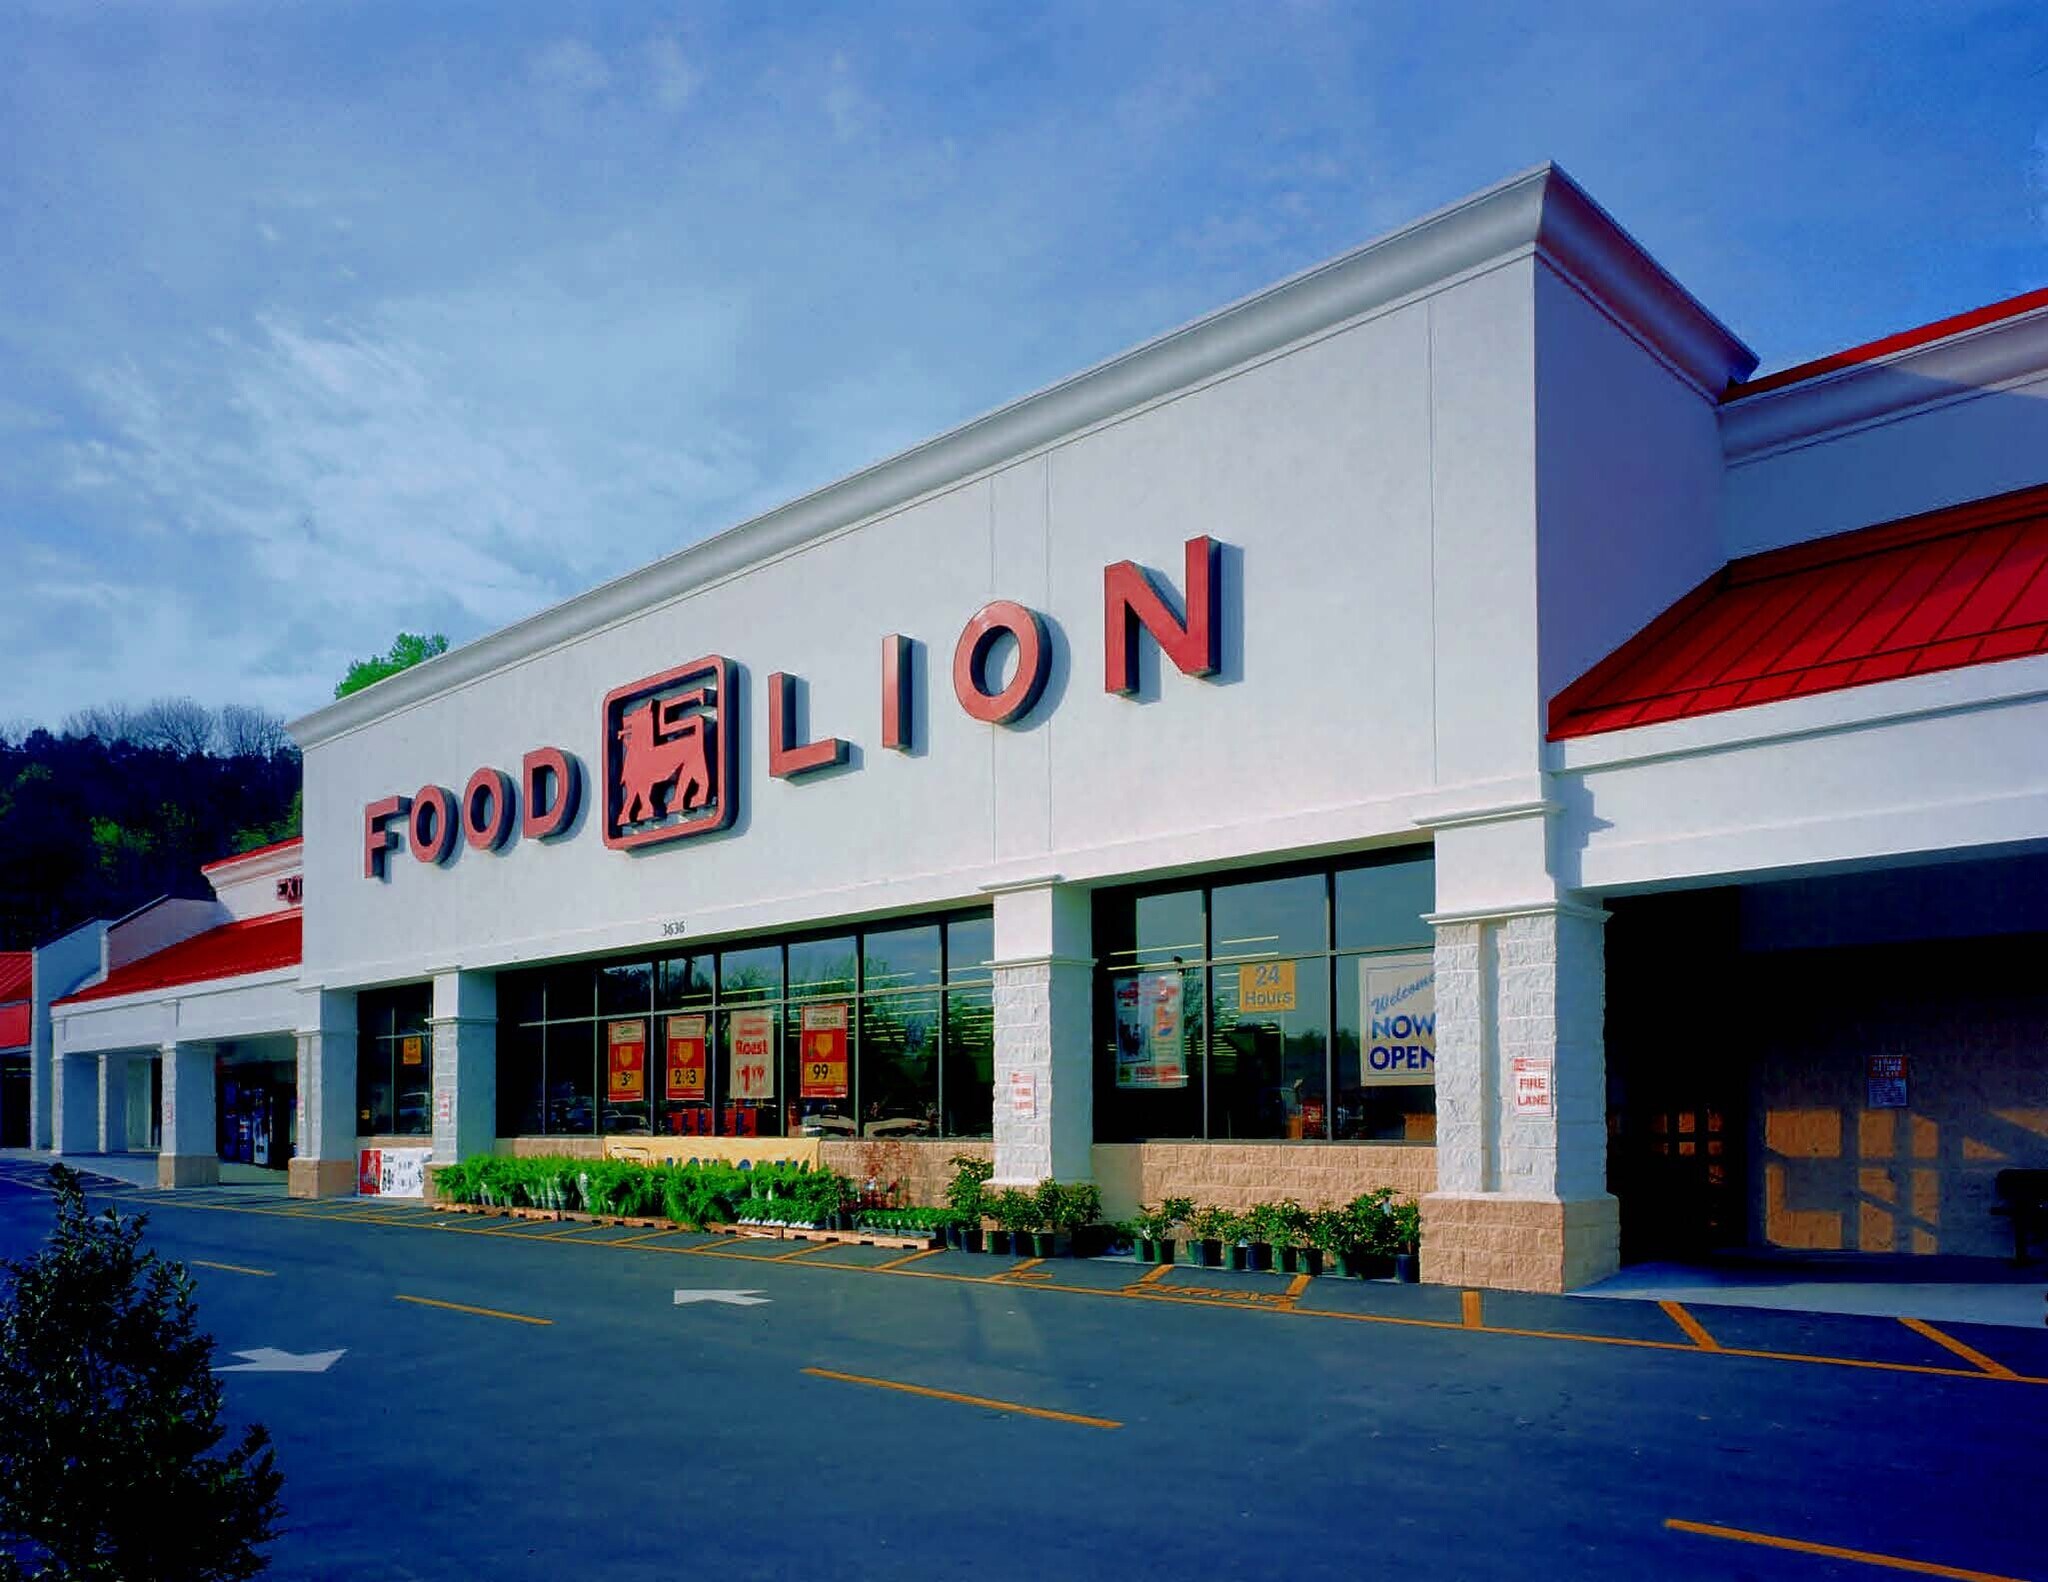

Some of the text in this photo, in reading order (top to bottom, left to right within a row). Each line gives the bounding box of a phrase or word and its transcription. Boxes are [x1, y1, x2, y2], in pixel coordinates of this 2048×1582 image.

[364, 534, 1222, 880] FOOD LION
[662, 920, 686, 936] 3636
[1254, 964, 1280, 987] 24
[1244, 989, 1294, 1007] Hours
[1371, 1013, 1436, 1039] NOW
[1369, 1045, 1435, 1070] OPEN
[1519, 1077, 1547, 1091] FIRE
[1517, 1094, 1549, 1107] LANE
